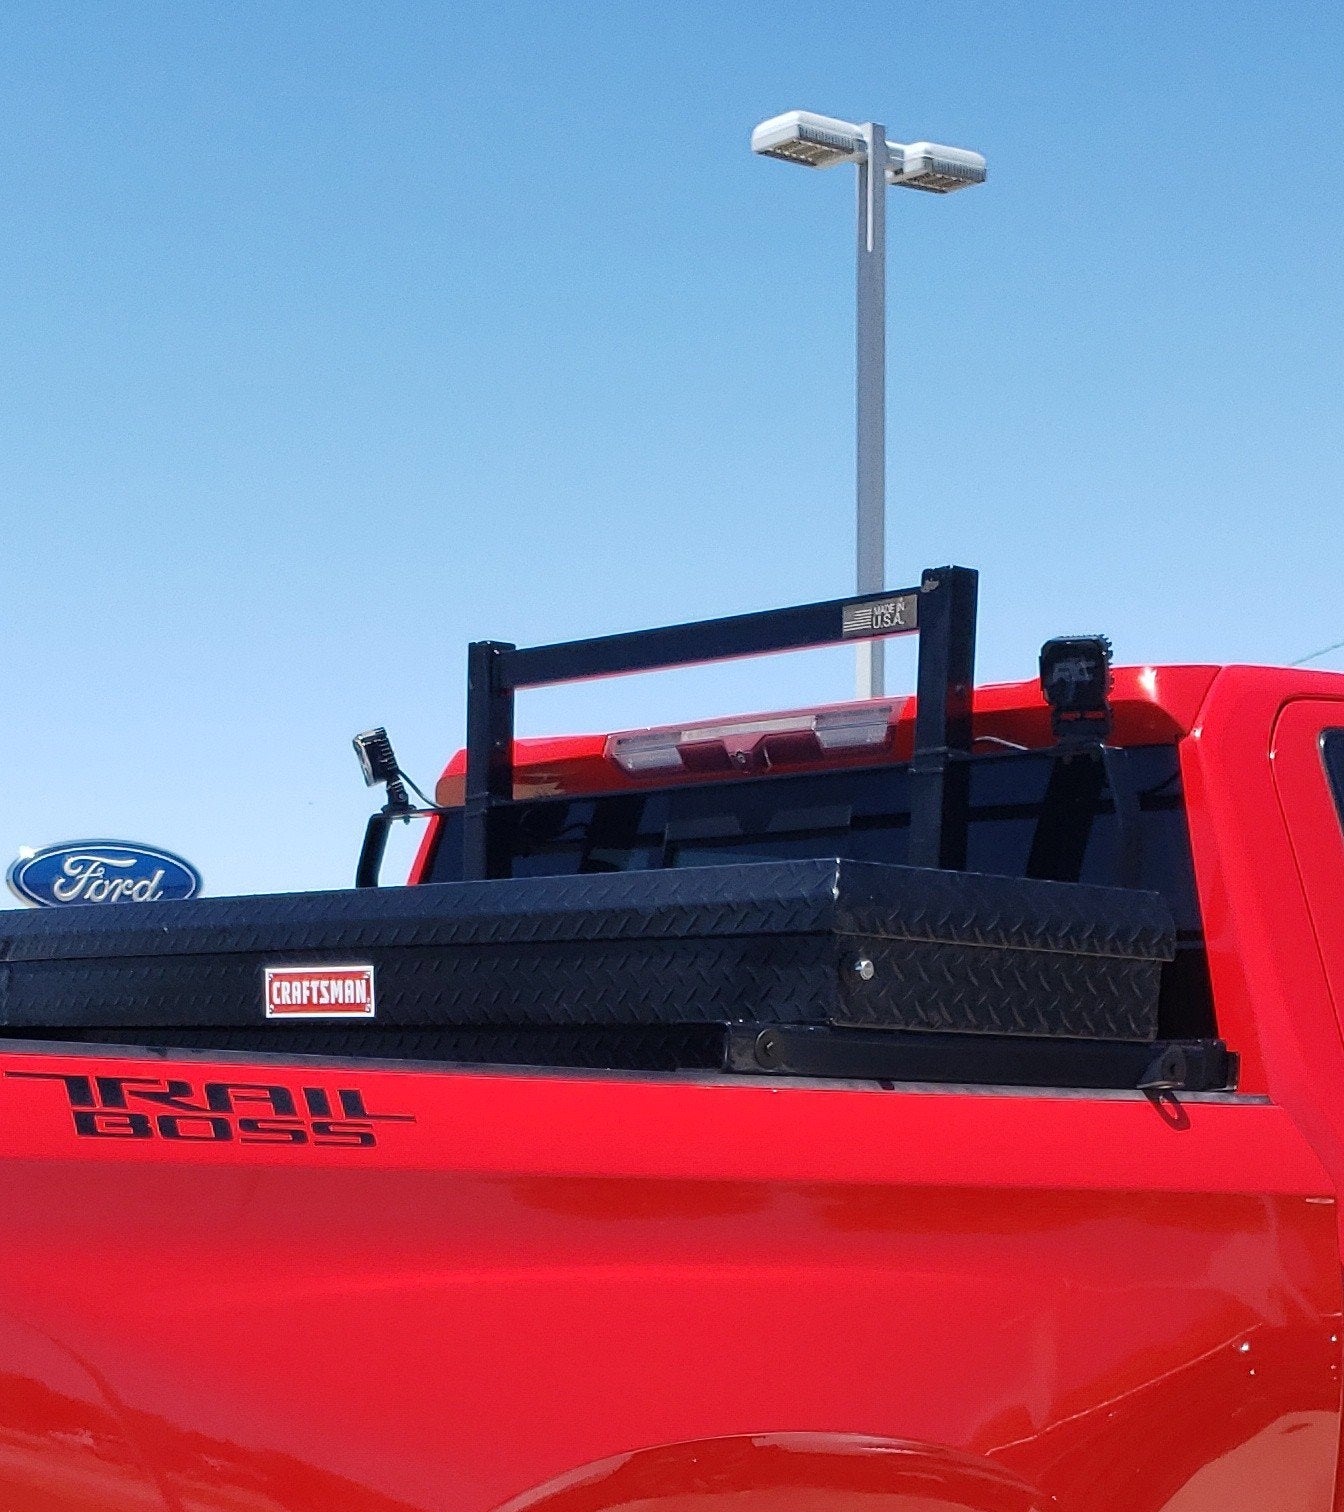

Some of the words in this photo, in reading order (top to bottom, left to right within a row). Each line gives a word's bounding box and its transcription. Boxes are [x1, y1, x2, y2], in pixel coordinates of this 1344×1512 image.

[53, 855, 166, 902] Ford
[272, 979, 368, 1005] CRAFTSMAN
[4, 1070, 417, 1123] TRAIL
[72, 1110, 378, 1147] BOSS
